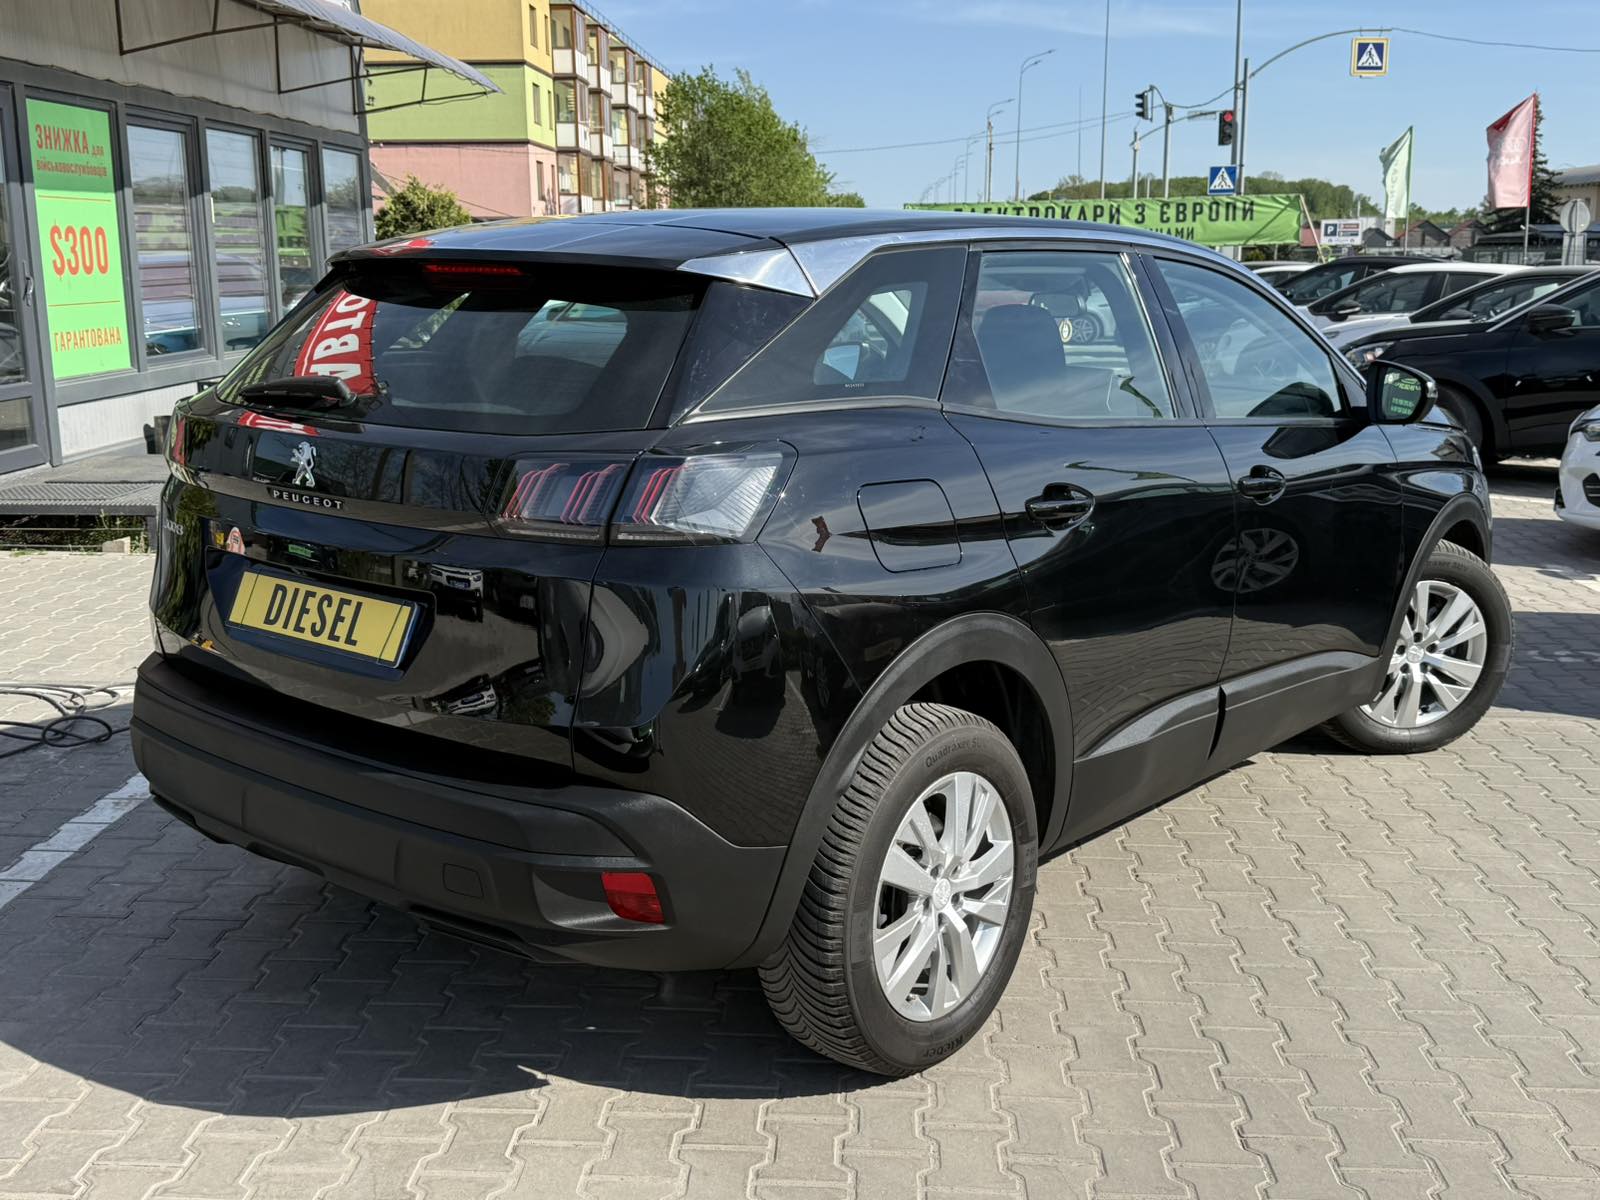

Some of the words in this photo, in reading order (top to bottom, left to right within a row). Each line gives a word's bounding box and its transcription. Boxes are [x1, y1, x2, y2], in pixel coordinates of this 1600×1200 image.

[35, 124, 89, 154] ЗНИЖКА
[954, 204, 1121, 224] ТРОКАРИ
[1134, 203, 1146, 224] З
[1160, 201, 1254, 223] ЄВРОПИ
[50, 219, 109, 280] $300
[54, 326, 122, 353] ГАРАНТОВАНА
[273, 490, 342, 510] PEUGEOT
[263, 583, 363, 647] DIESEL
